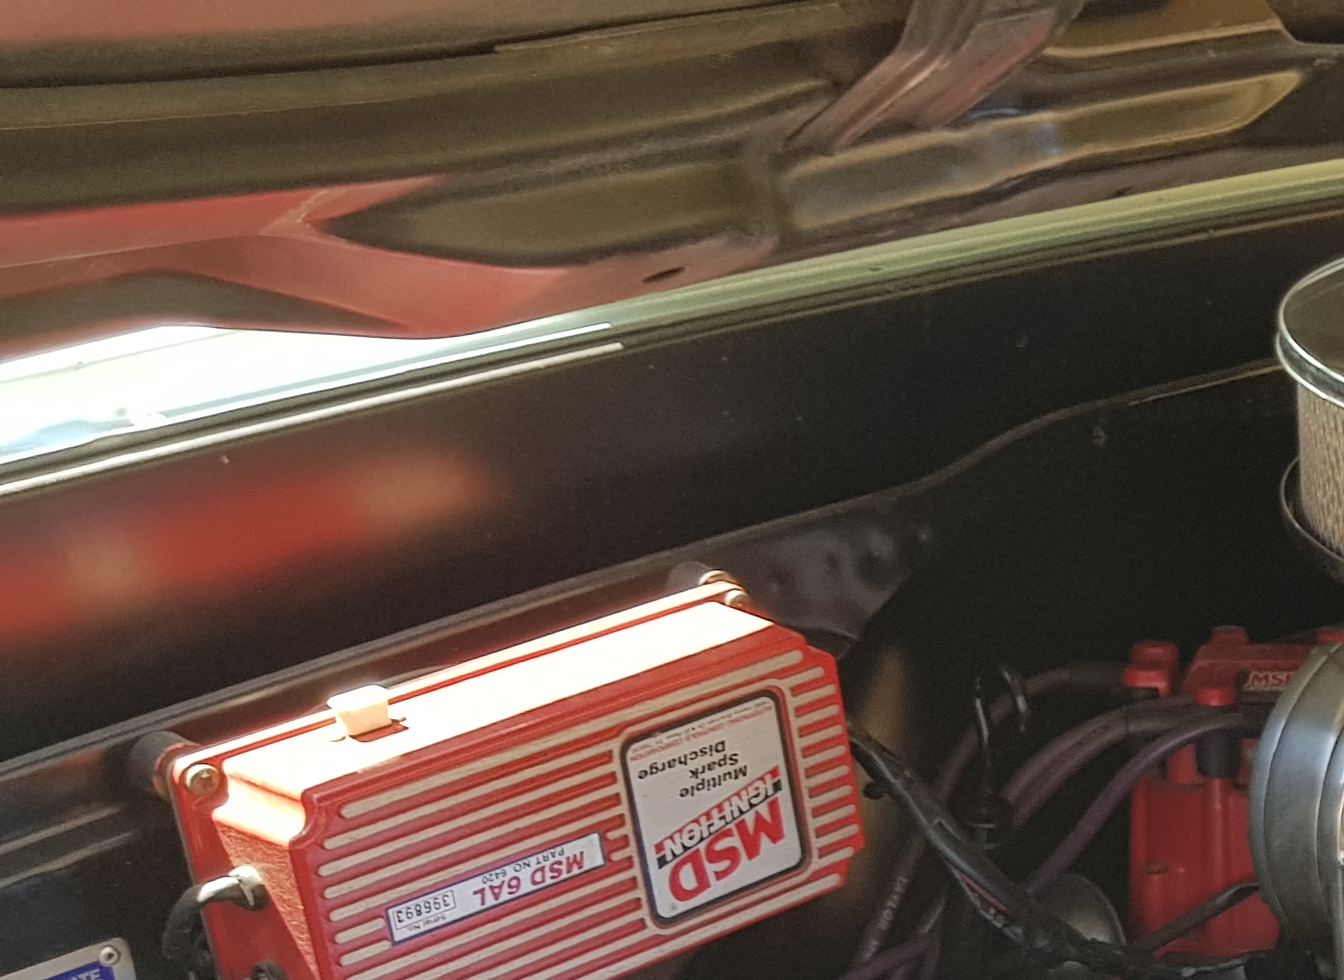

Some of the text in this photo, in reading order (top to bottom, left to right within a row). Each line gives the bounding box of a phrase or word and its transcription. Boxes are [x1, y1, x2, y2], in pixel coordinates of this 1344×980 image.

[637, 740, 727, 780] Discharge
[689, 753, 741, 780] Spark
[679, 765, 749, 799] Multiple
[656, 769, 779, 865] IGNITION
[534, 847, 565, 865] PART
[669, 797, 785, 902] MSD
[472, 851, 585, 905] MSD 6AL
[482, 868, 507, 884] 6420
[396, 893, 450, 923] 396893
